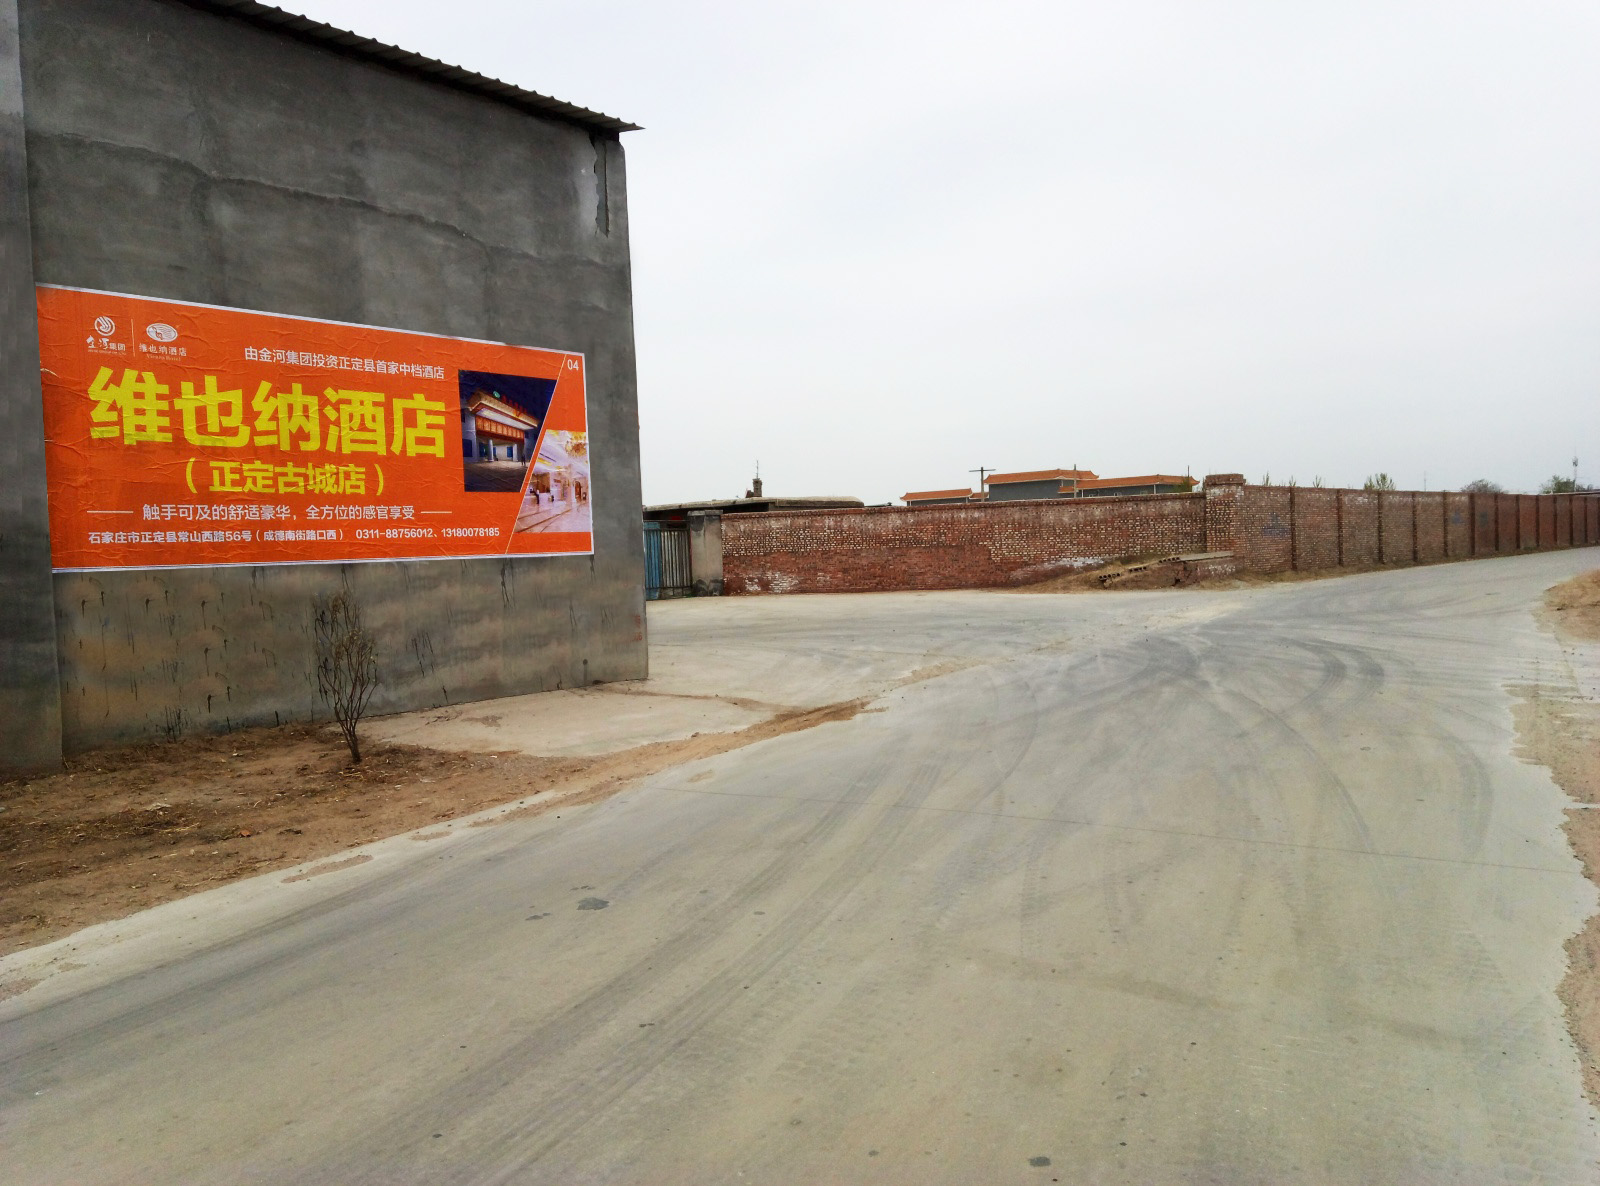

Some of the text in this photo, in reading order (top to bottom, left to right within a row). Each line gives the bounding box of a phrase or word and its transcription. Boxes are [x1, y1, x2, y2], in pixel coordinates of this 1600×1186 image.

[139, 342, 187, 356] 维也纳酒店
[244, 346, 445, 379] 由金河集团投资正定县首家中档酒店
[567, 359, 579, 370] 04
[88, 366, 446, 457] 维也纳酒店
